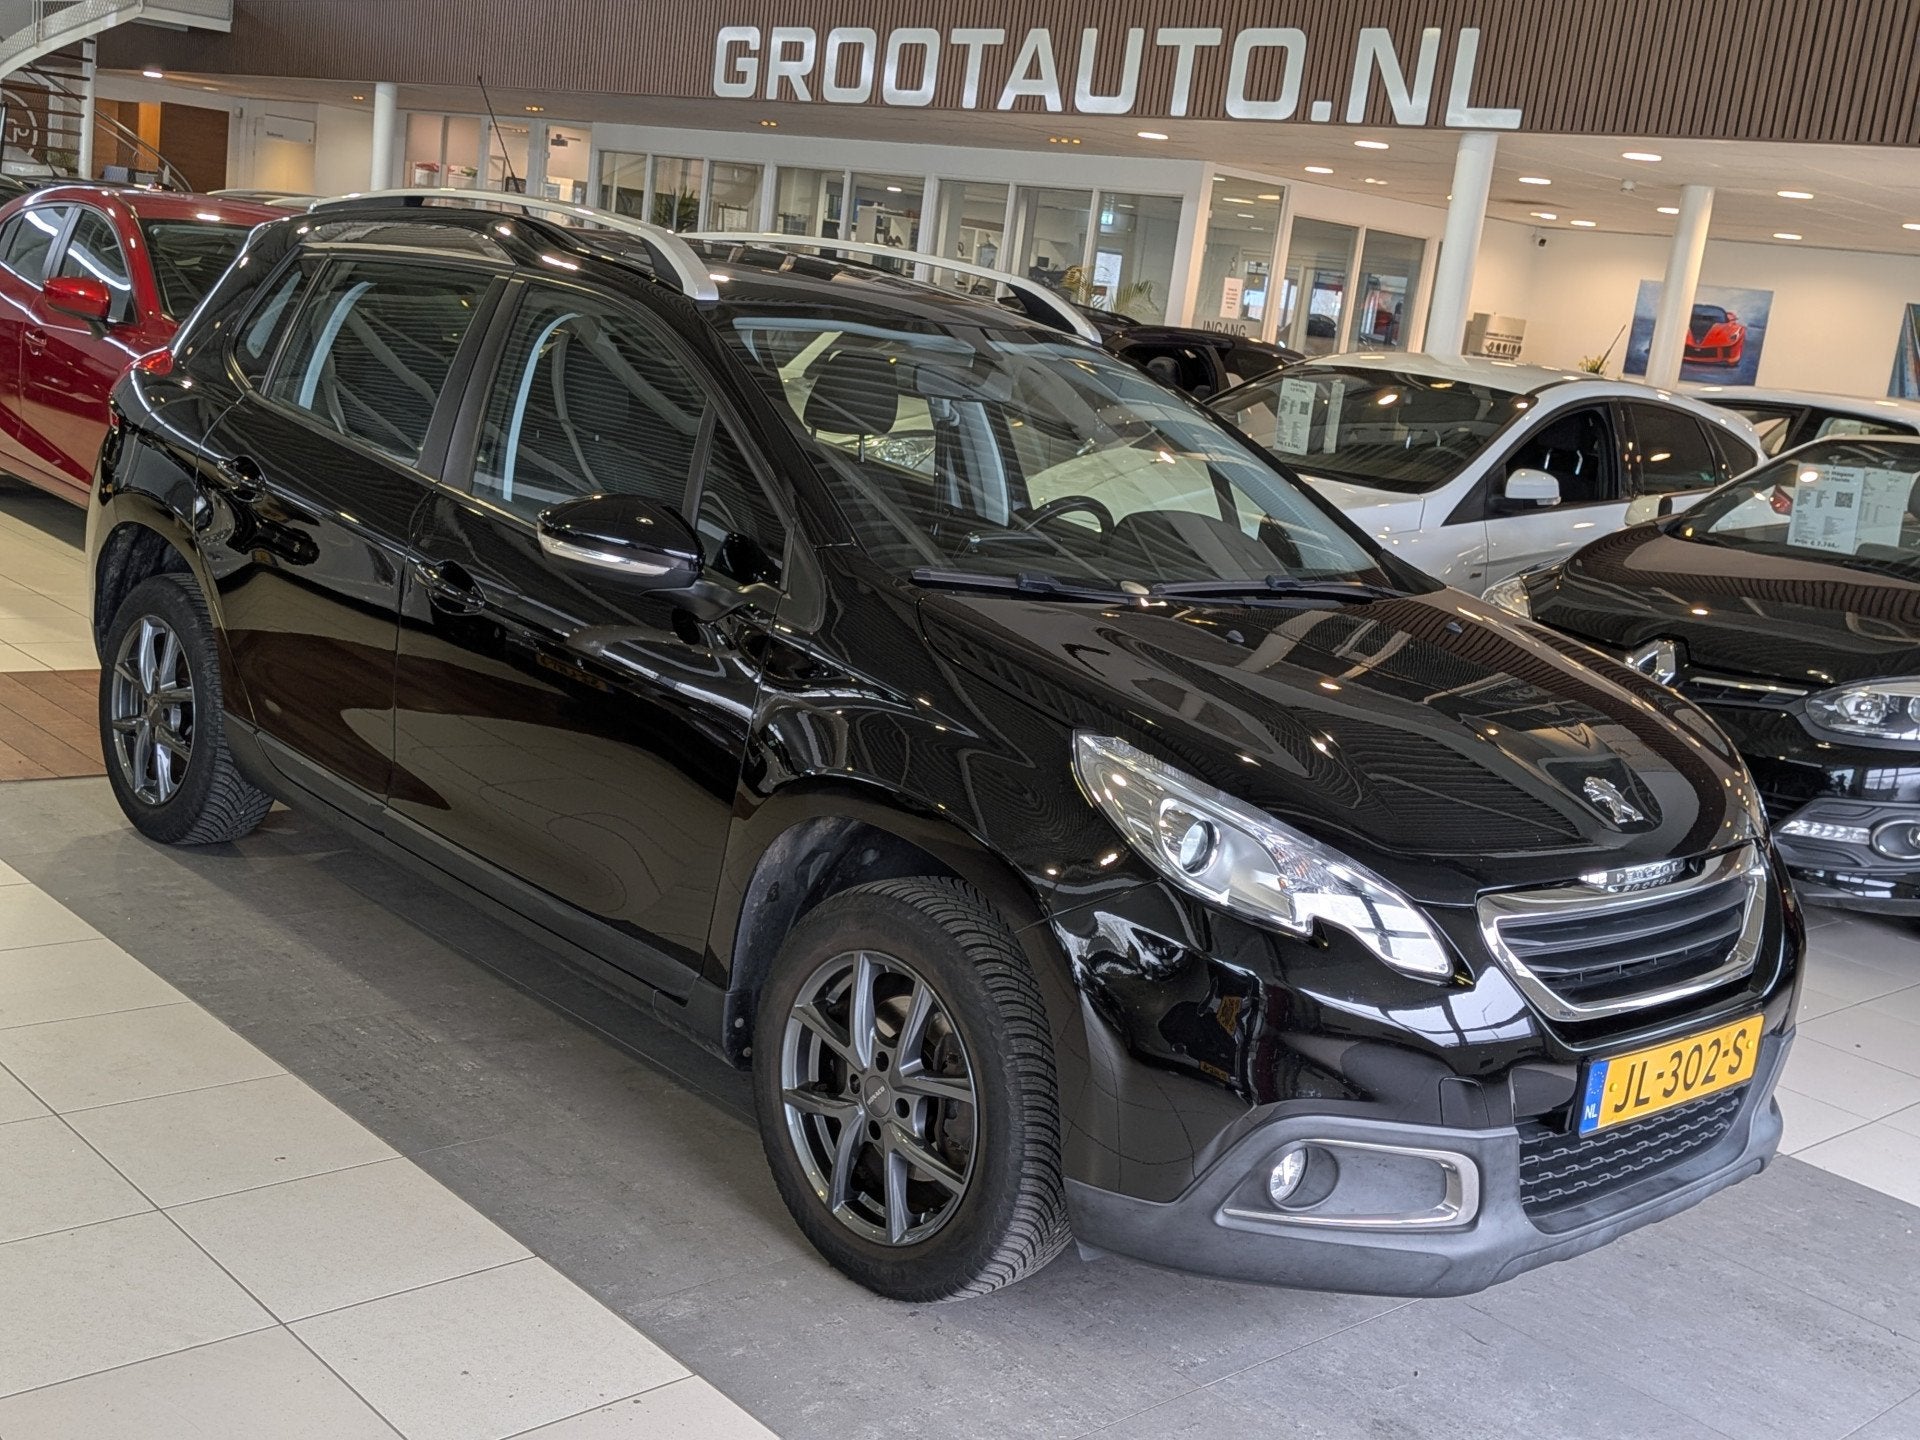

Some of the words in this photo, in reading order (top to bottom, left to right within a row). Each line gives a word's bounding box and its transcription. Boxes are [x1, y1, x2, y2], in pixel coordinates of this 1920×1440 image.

[714, 27, 1522, 129] GROOTAUTO.NL
[1202, 320, 1246, 337] INGANG
[1616, 861, 1678, 883] PEUGEOT
[1613, 1028, 1748, 1113] JL-302-S
[1584, 1104, 1598, 1121] NL
